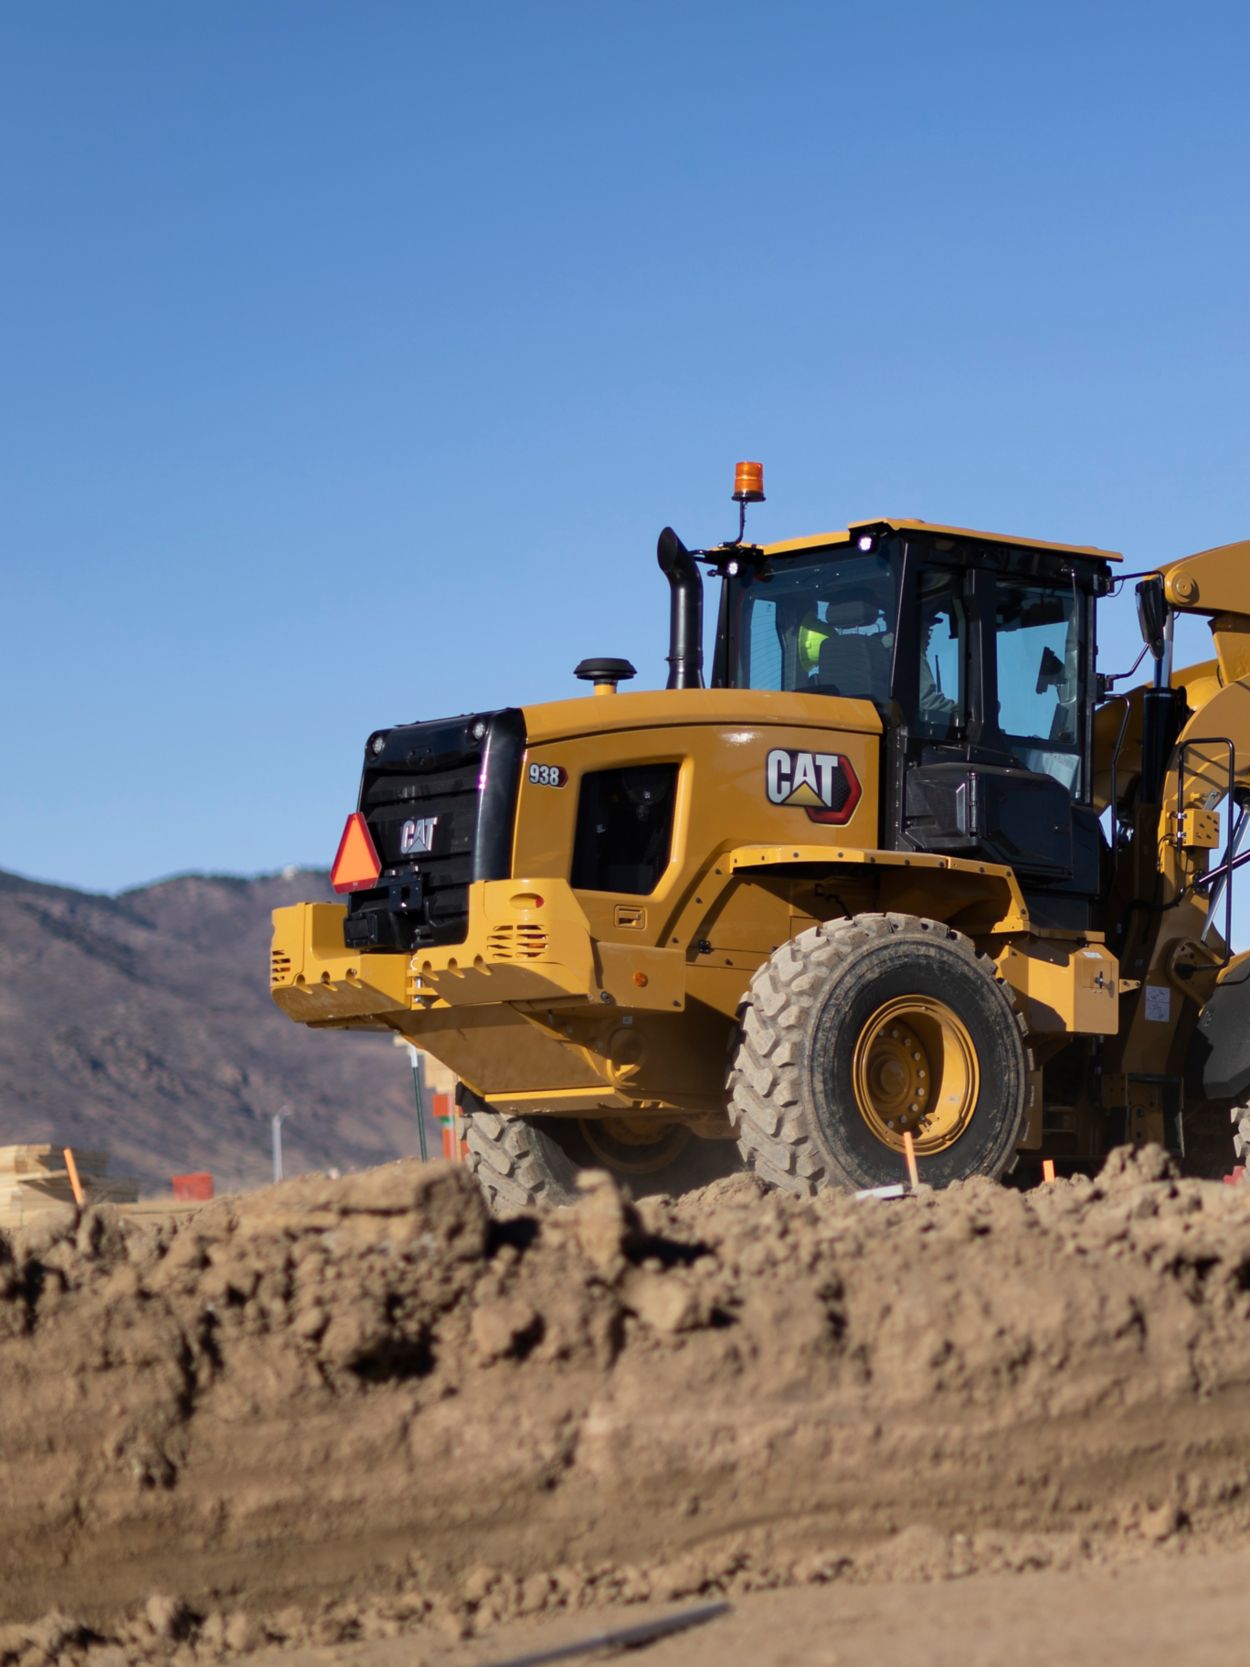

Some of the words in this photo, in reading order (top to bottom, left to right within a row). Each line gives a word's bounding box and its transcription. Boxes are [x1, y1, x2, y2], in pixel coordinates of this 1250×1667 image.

[529, 764, 560, 786] 938
[767, 749, 838, 807] CAT
[400, 817, 438, 854] CAT
